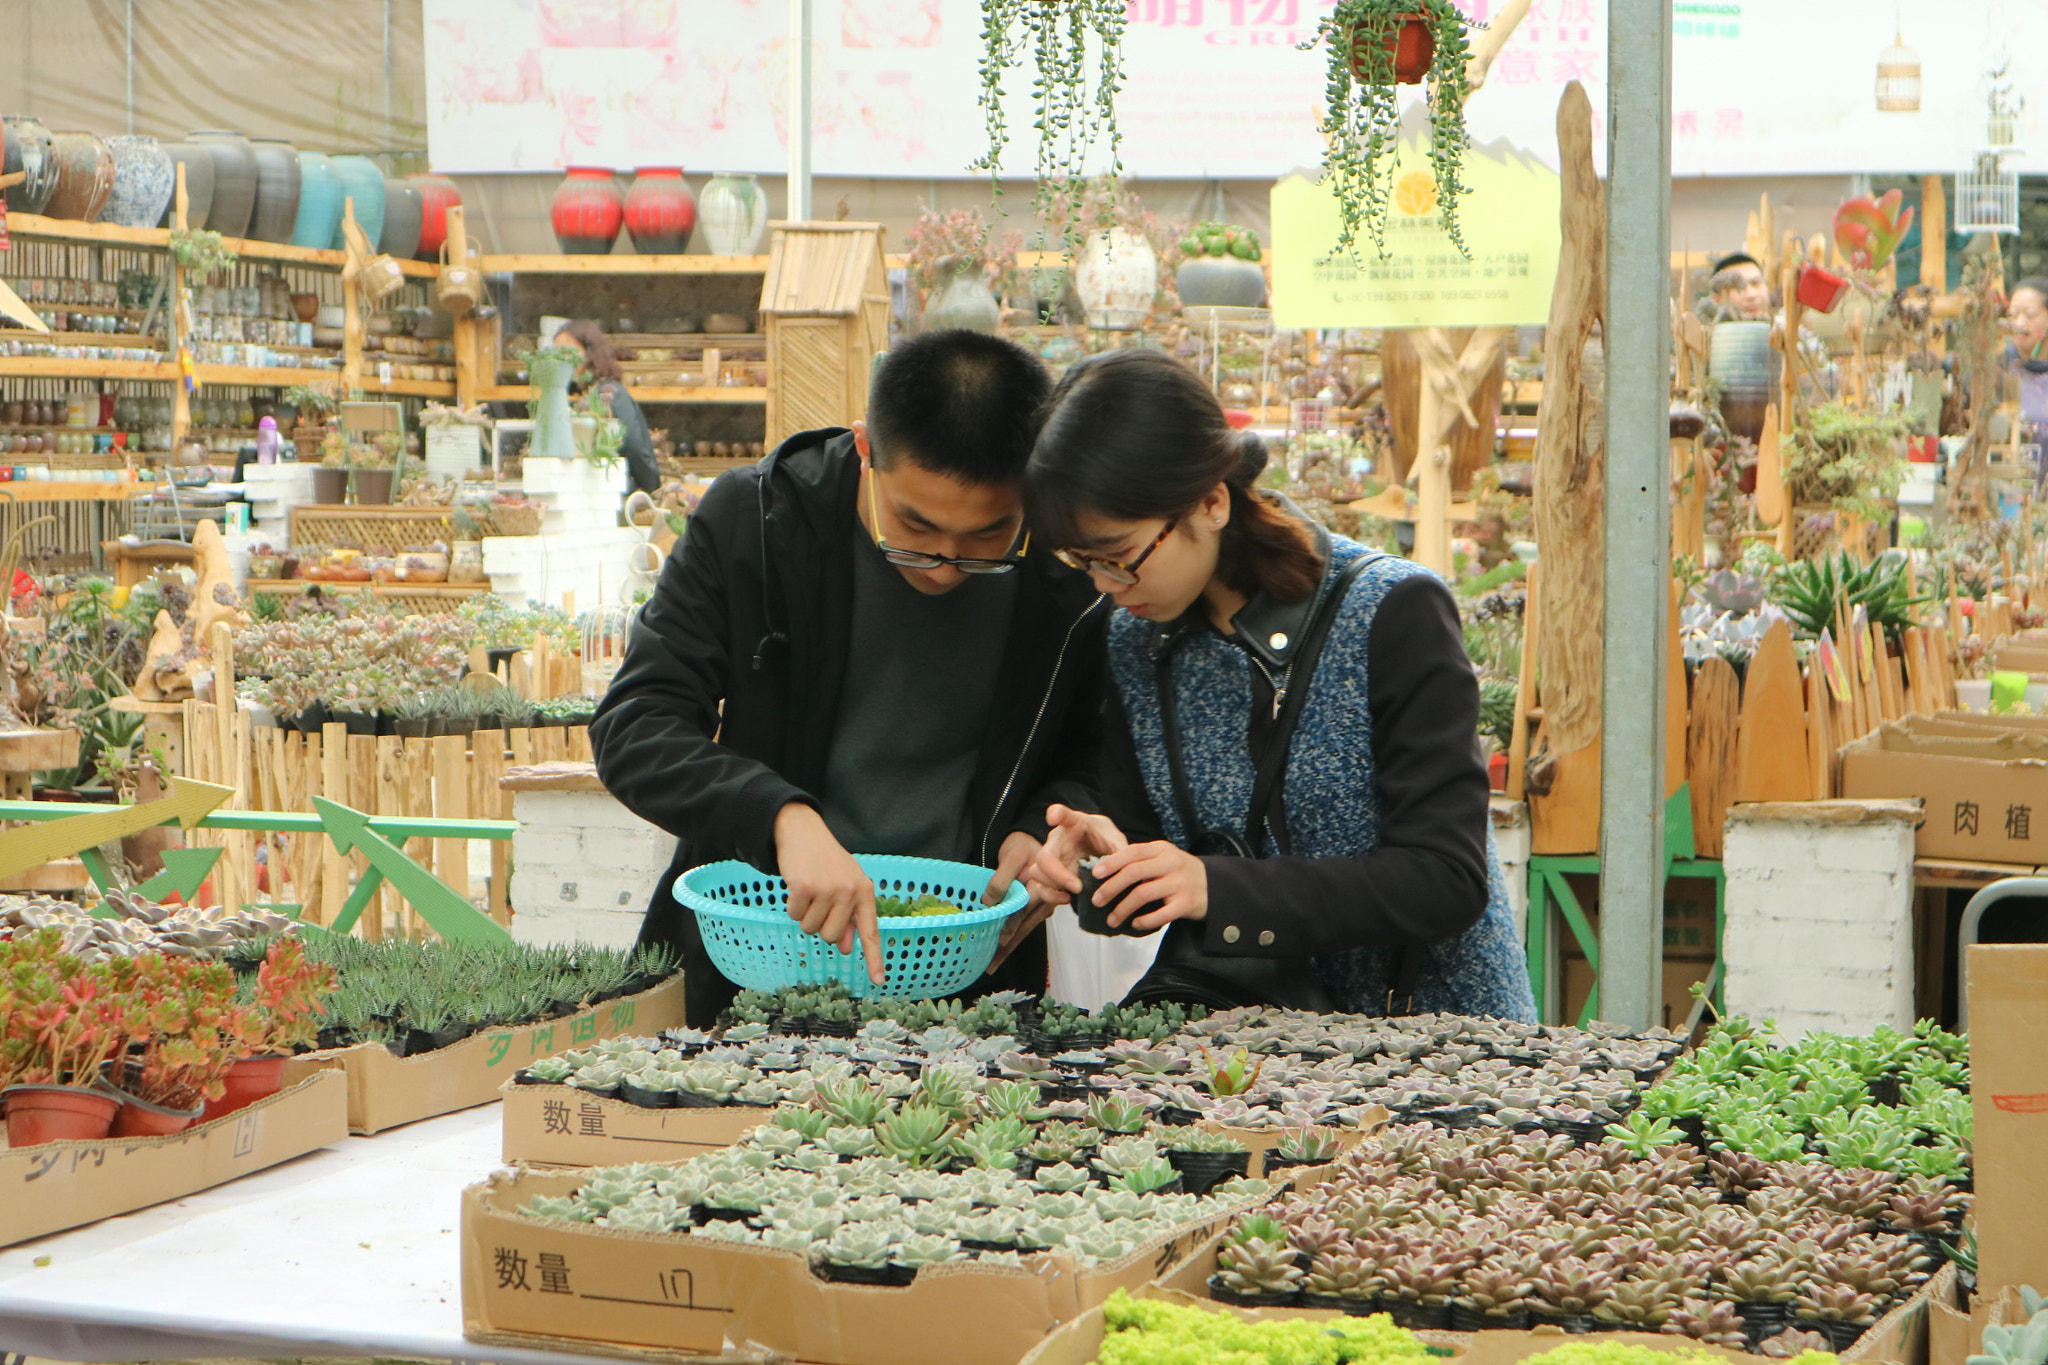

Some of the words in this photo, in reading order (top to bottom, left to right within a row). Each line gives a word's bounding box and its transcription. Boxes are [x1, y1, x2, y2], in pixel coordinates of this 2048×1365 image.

[543, 1099, 607, 1138] 数量
[493, 1246, 575, 1296] 数量
[659, 1268, 694, 1311] 17
